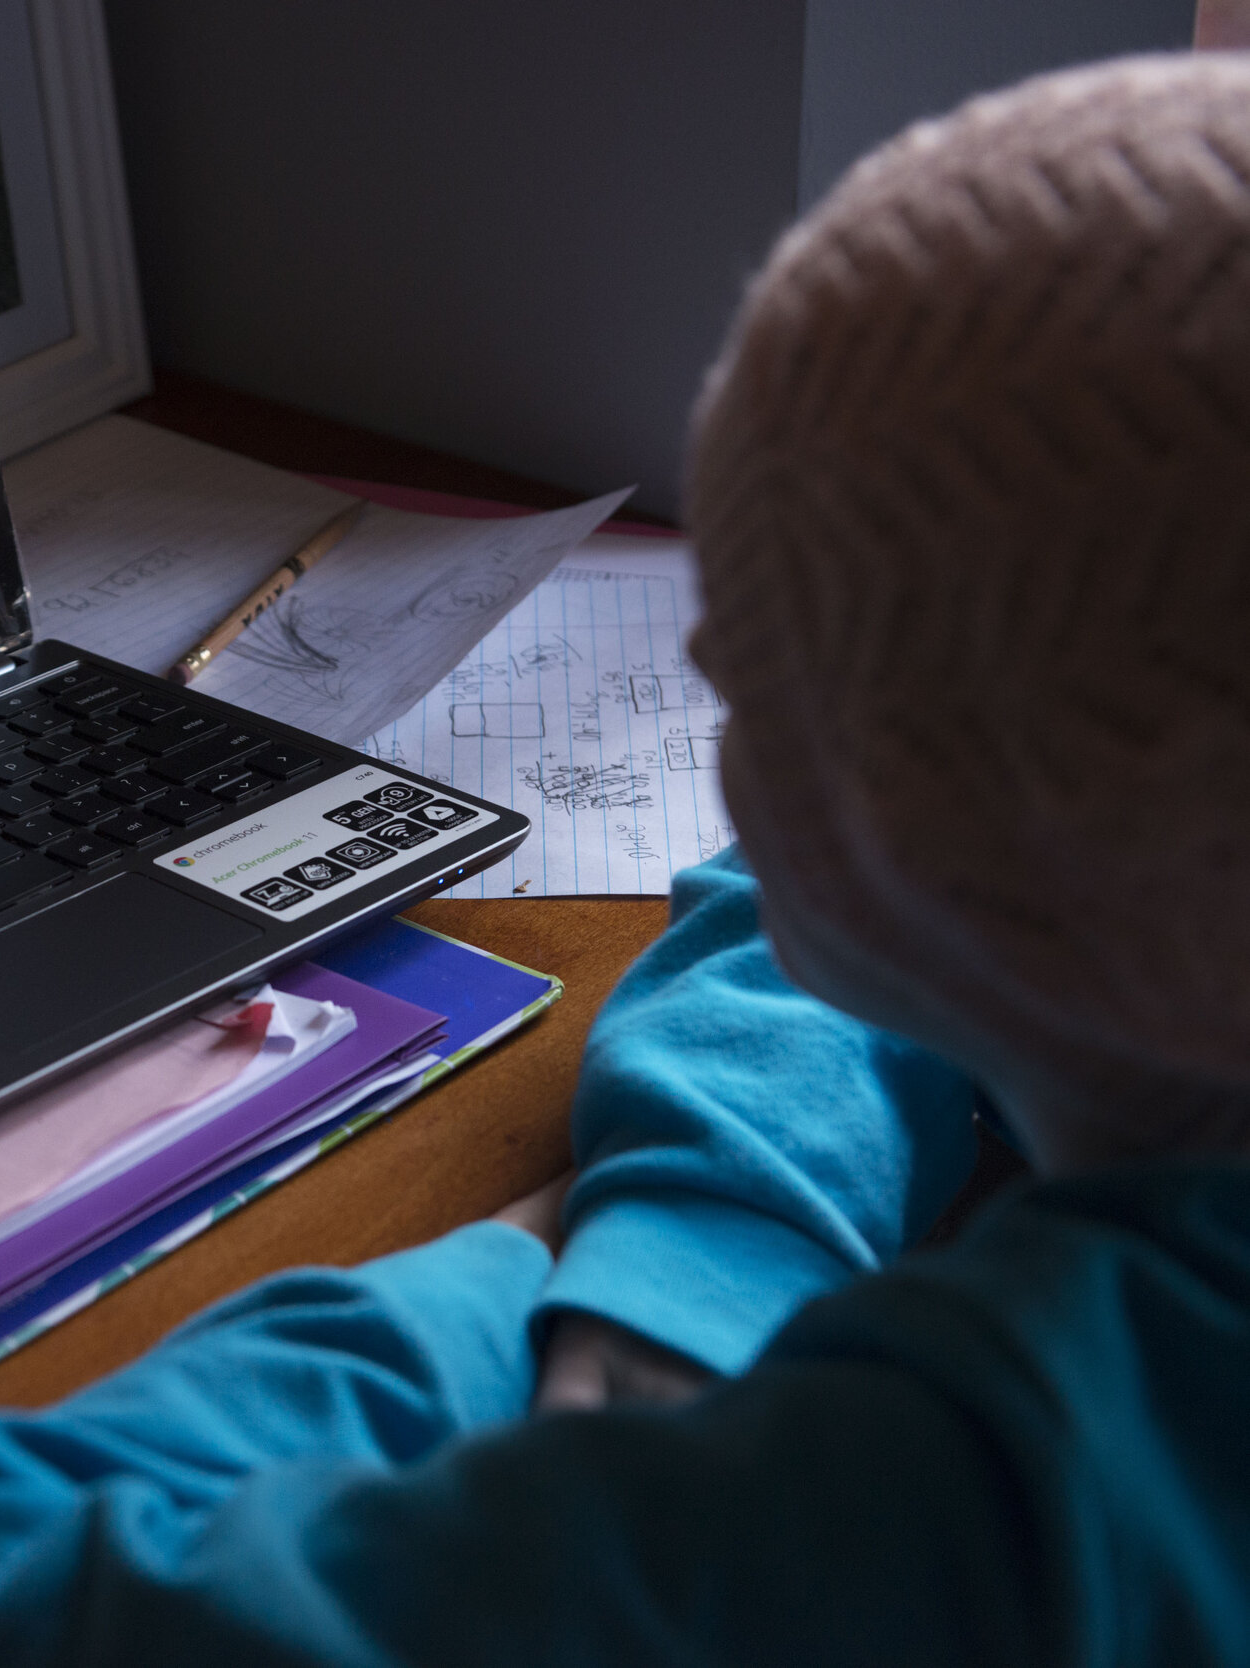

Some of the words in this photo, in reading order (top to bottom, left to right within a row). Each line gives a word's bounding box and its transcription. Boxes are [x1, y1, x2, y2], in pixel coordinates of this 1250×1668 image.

[669, 741, 687, 763] 270
[354, 770, 374, 782] C740
[350, 805, 378, 819] GEN
[193, 822, 268, 859] chromebook
[212, 868, 238, 885] Acer
[237, 837, 307, 872] Chromebook
[302, 831, 319, 841] 11
